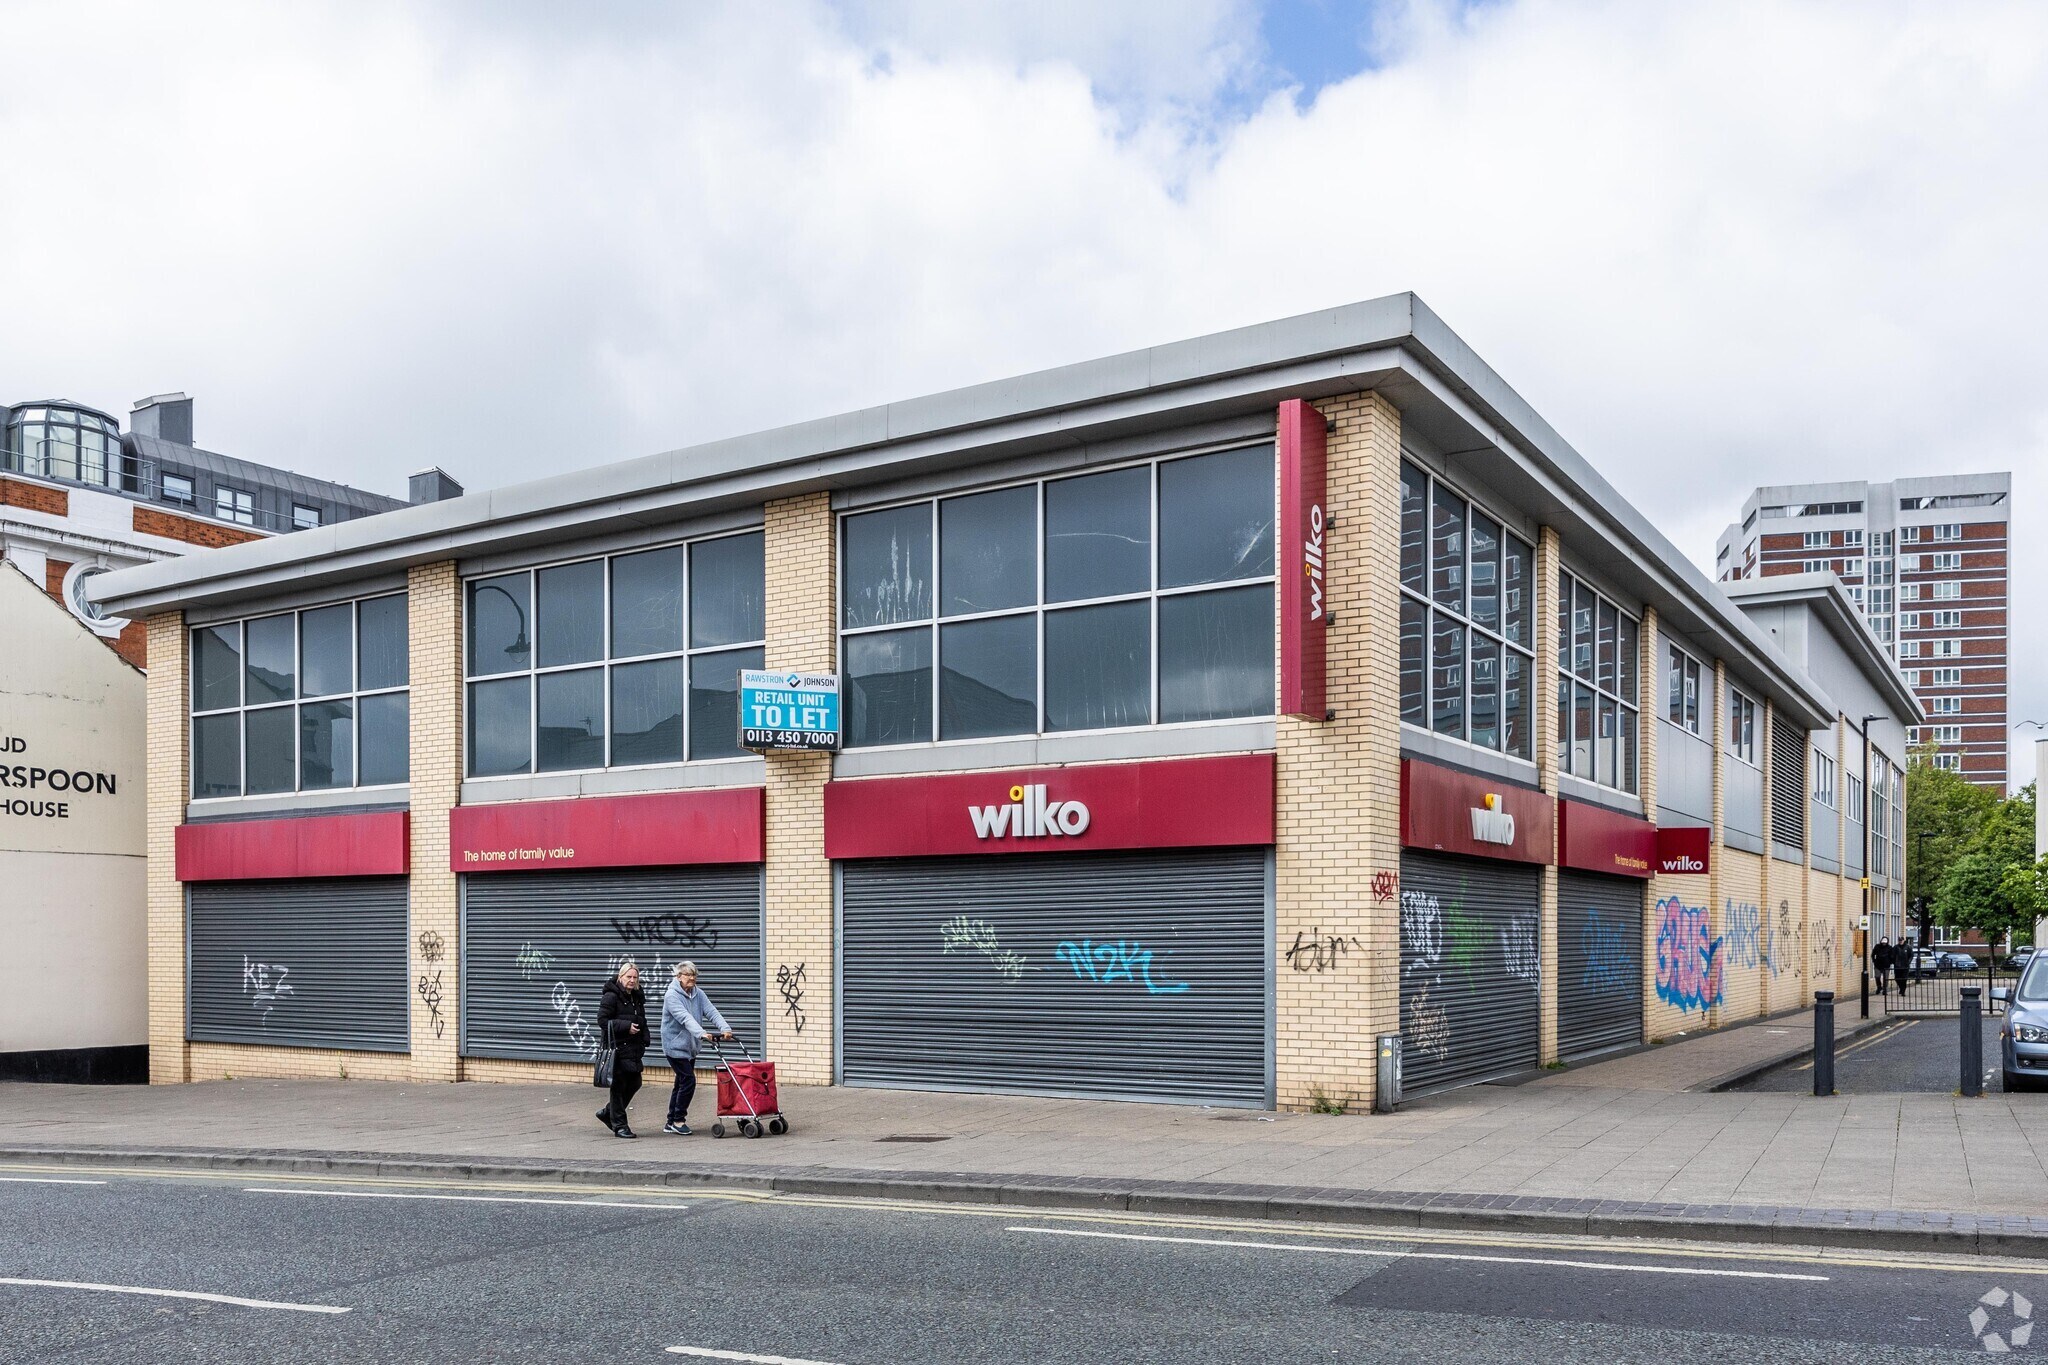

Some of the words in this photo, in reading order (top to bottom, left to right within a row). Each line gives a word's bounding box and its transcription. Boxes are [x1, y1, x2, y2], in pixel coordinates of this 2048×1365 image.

[1305, 503, 1323, 621] wilko
[745, 673, 784, 684] RAWSTRON
[803, 677, 835, 687] JOHNSON
[755, 691, 795, 705] RETAIL
[797, 693, 826, 706] UNIT
[751, 704, 782, 728] TO
[789, 706, 830, 729] LET
[747, 729, 773, 742] 0113
[776, 730, 801, 744] 450
[803, 731, 835, 745] 7000
[0, 799, 69, 818] HOUSE
[968, 783, 1091, 839] wilko
[464, 850, 479, 862] The
[481, 850, 507, 861] home
[508, 848, 518, 860] of
[519, 847, 547, 861] family
[548, 846, 575, 858] value
[1662, 855, 1704, 871] wilko
